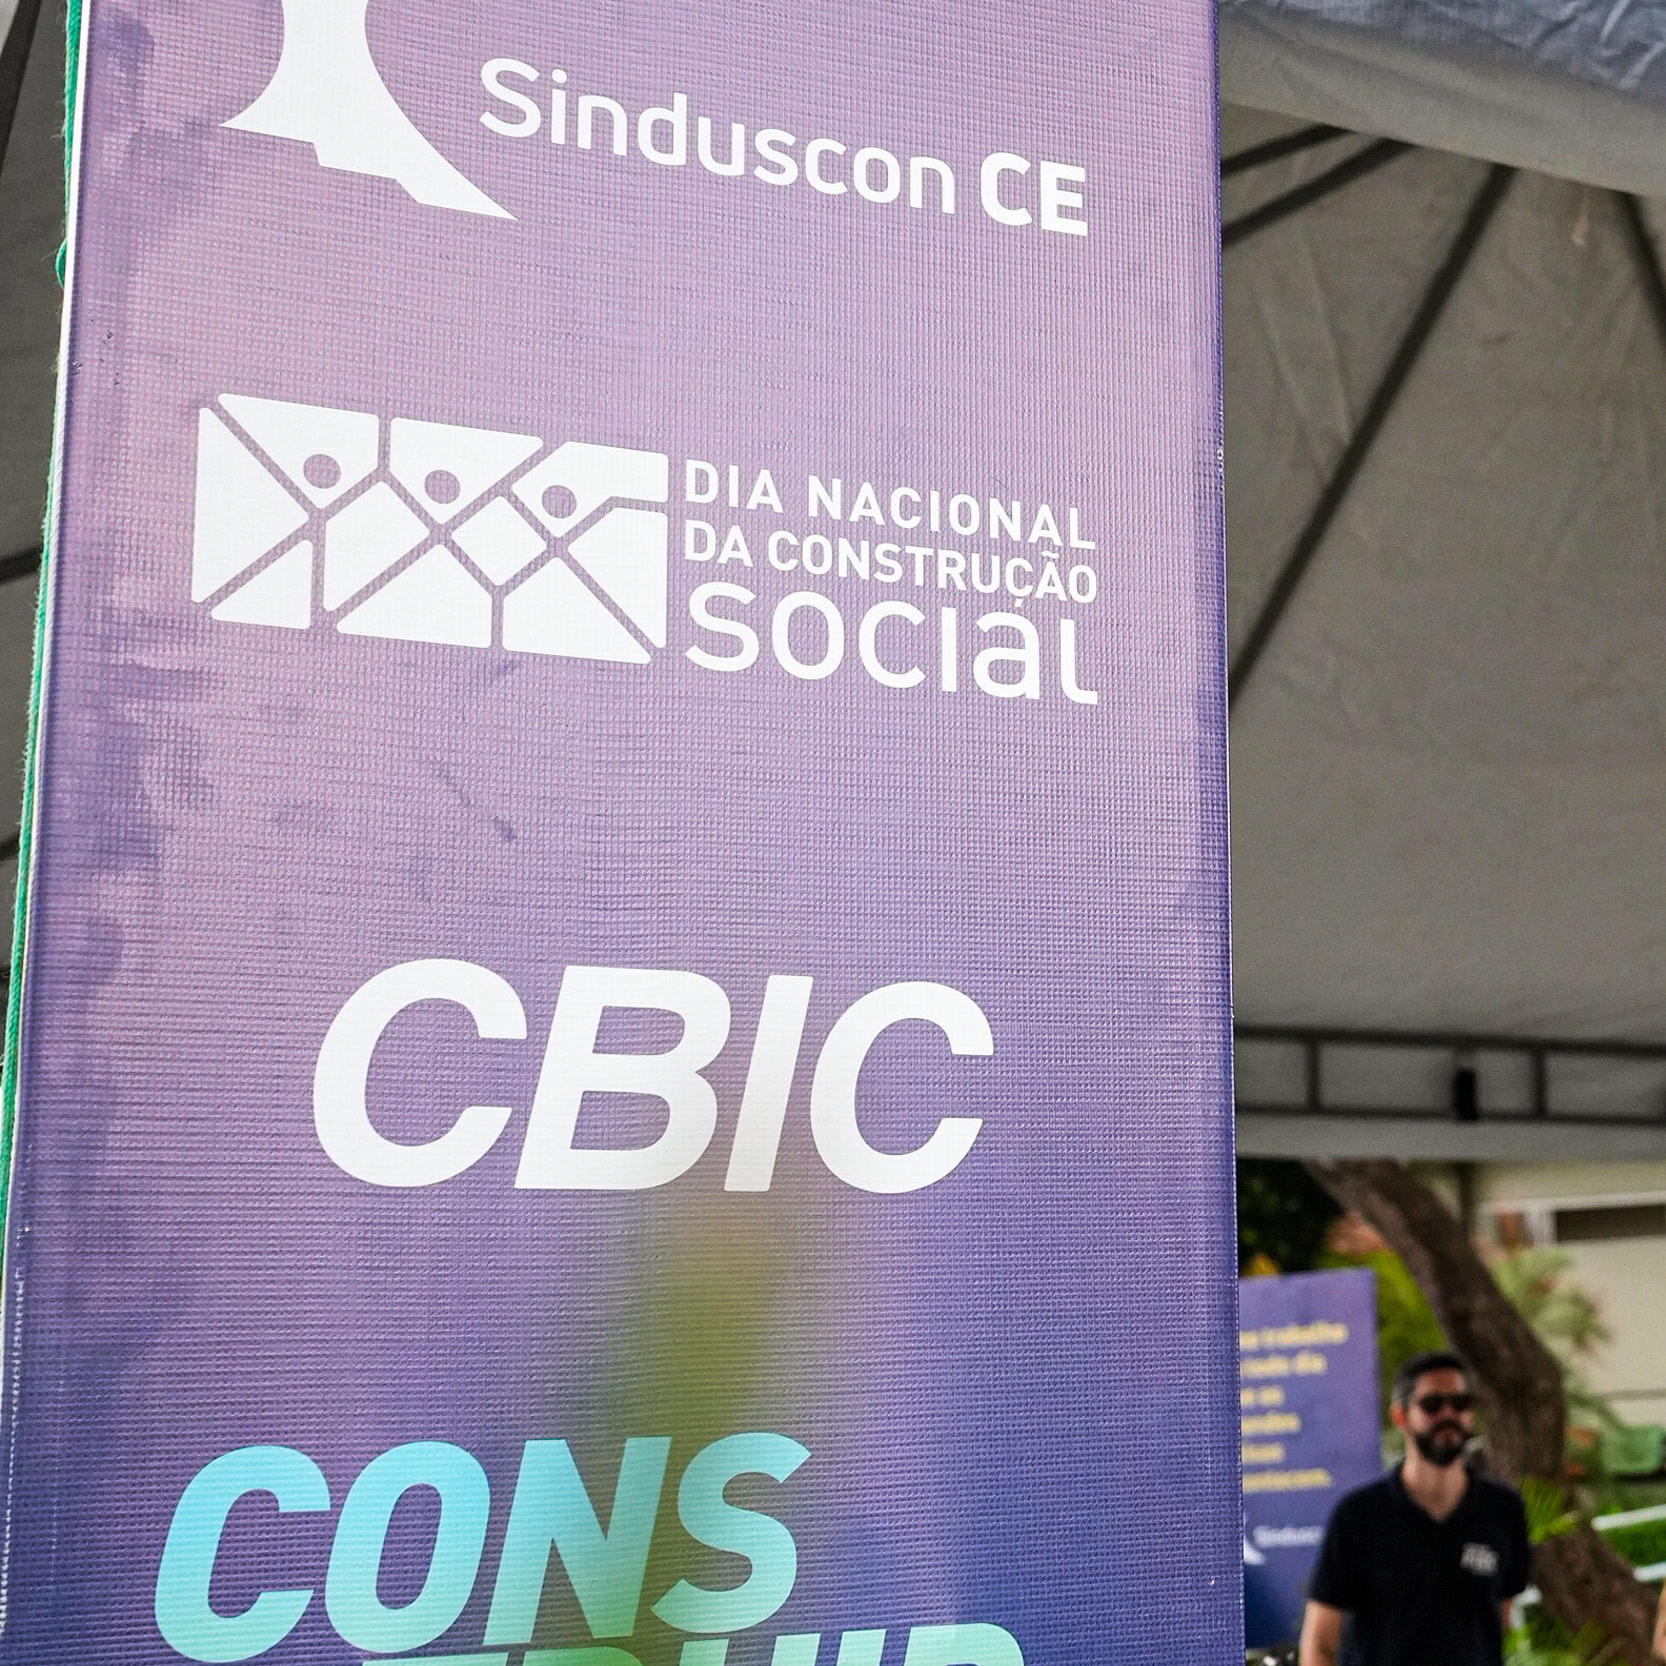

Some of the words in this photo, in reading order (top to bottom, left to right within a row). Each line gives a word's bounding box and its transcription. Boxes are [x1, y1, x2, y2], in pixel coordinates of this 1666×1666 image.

[479, 57, 956, 215] Sinduscon
[980, 152, 1089, 237] CE
[683, 518, 754, 568] DA
[767, 530, 1099, 607] CONSTRUÇÃO
[684, 458, 784, 514] DIA
[808, 474, 1096, 550] NACIONAL
[312, 958, 995, 1193] CBIC
[153, 1432, 812, 1663] CONS
